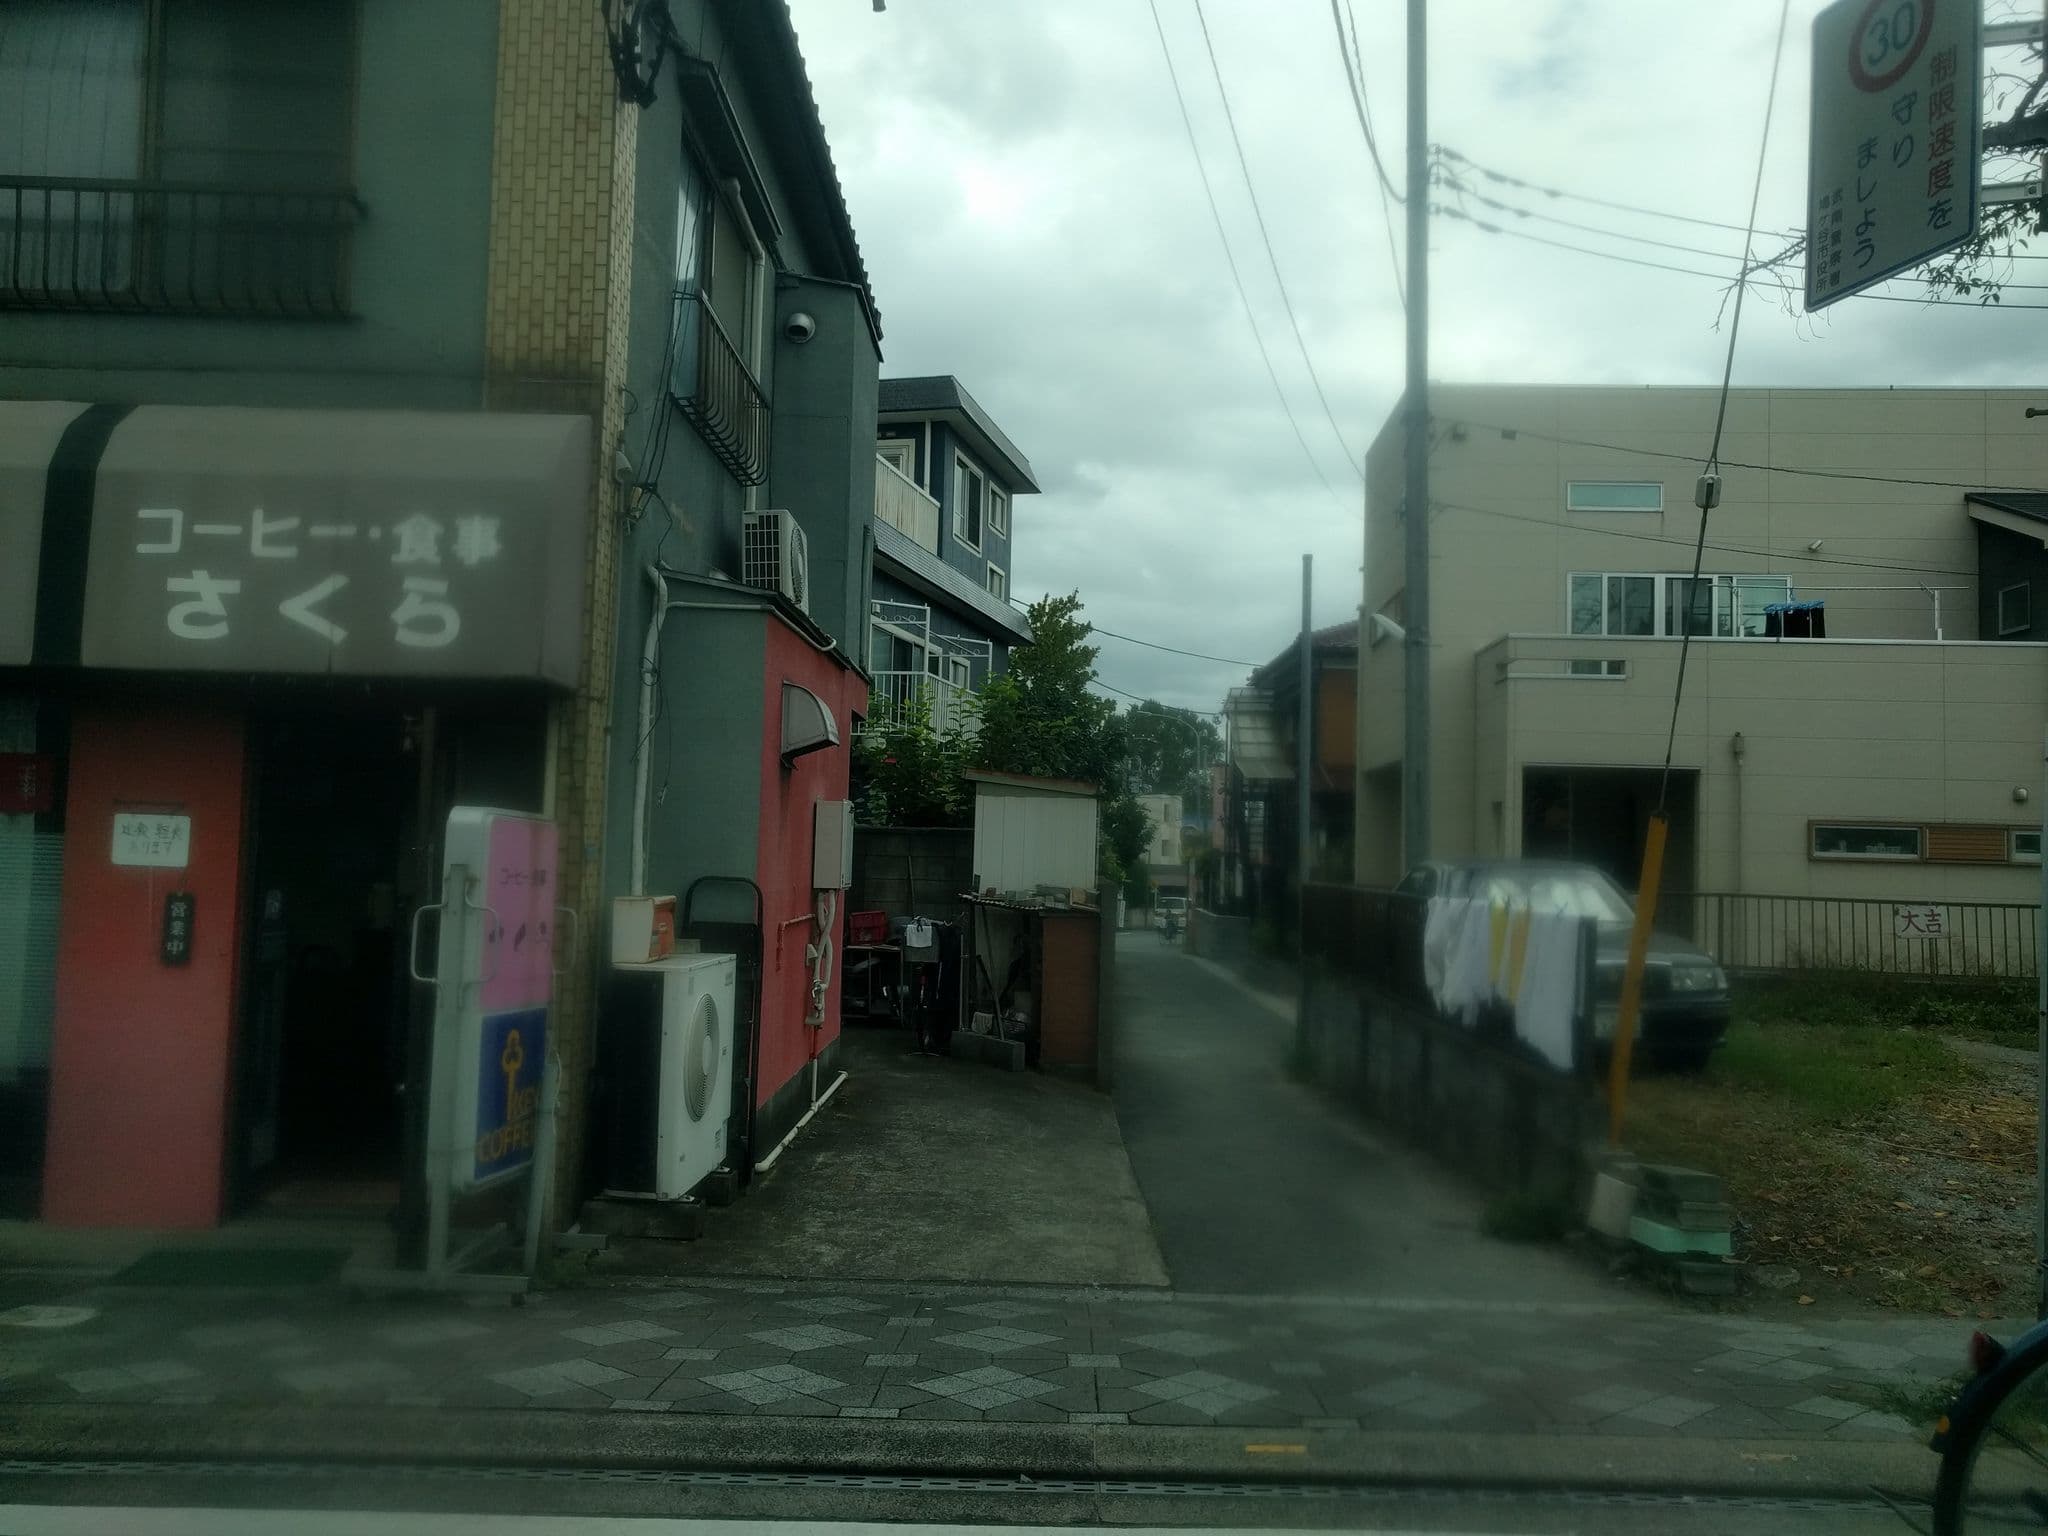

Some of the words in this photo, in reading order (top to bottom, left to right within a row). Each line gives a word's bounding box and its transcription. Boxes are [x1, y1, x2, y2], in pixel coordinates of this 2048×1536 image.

[1867, 2, 1915, 66] 30
[1891, 90, 1917, 168] 守り
[1927, 45, 1957, 231] 制限速度を
[136, 507, 501, 565] コーヒー・食事
[166, 569, 461, 648] さくら
[167, 901, 187, 955] 営業中
[1901, 909, 1942, 933] 大吉
